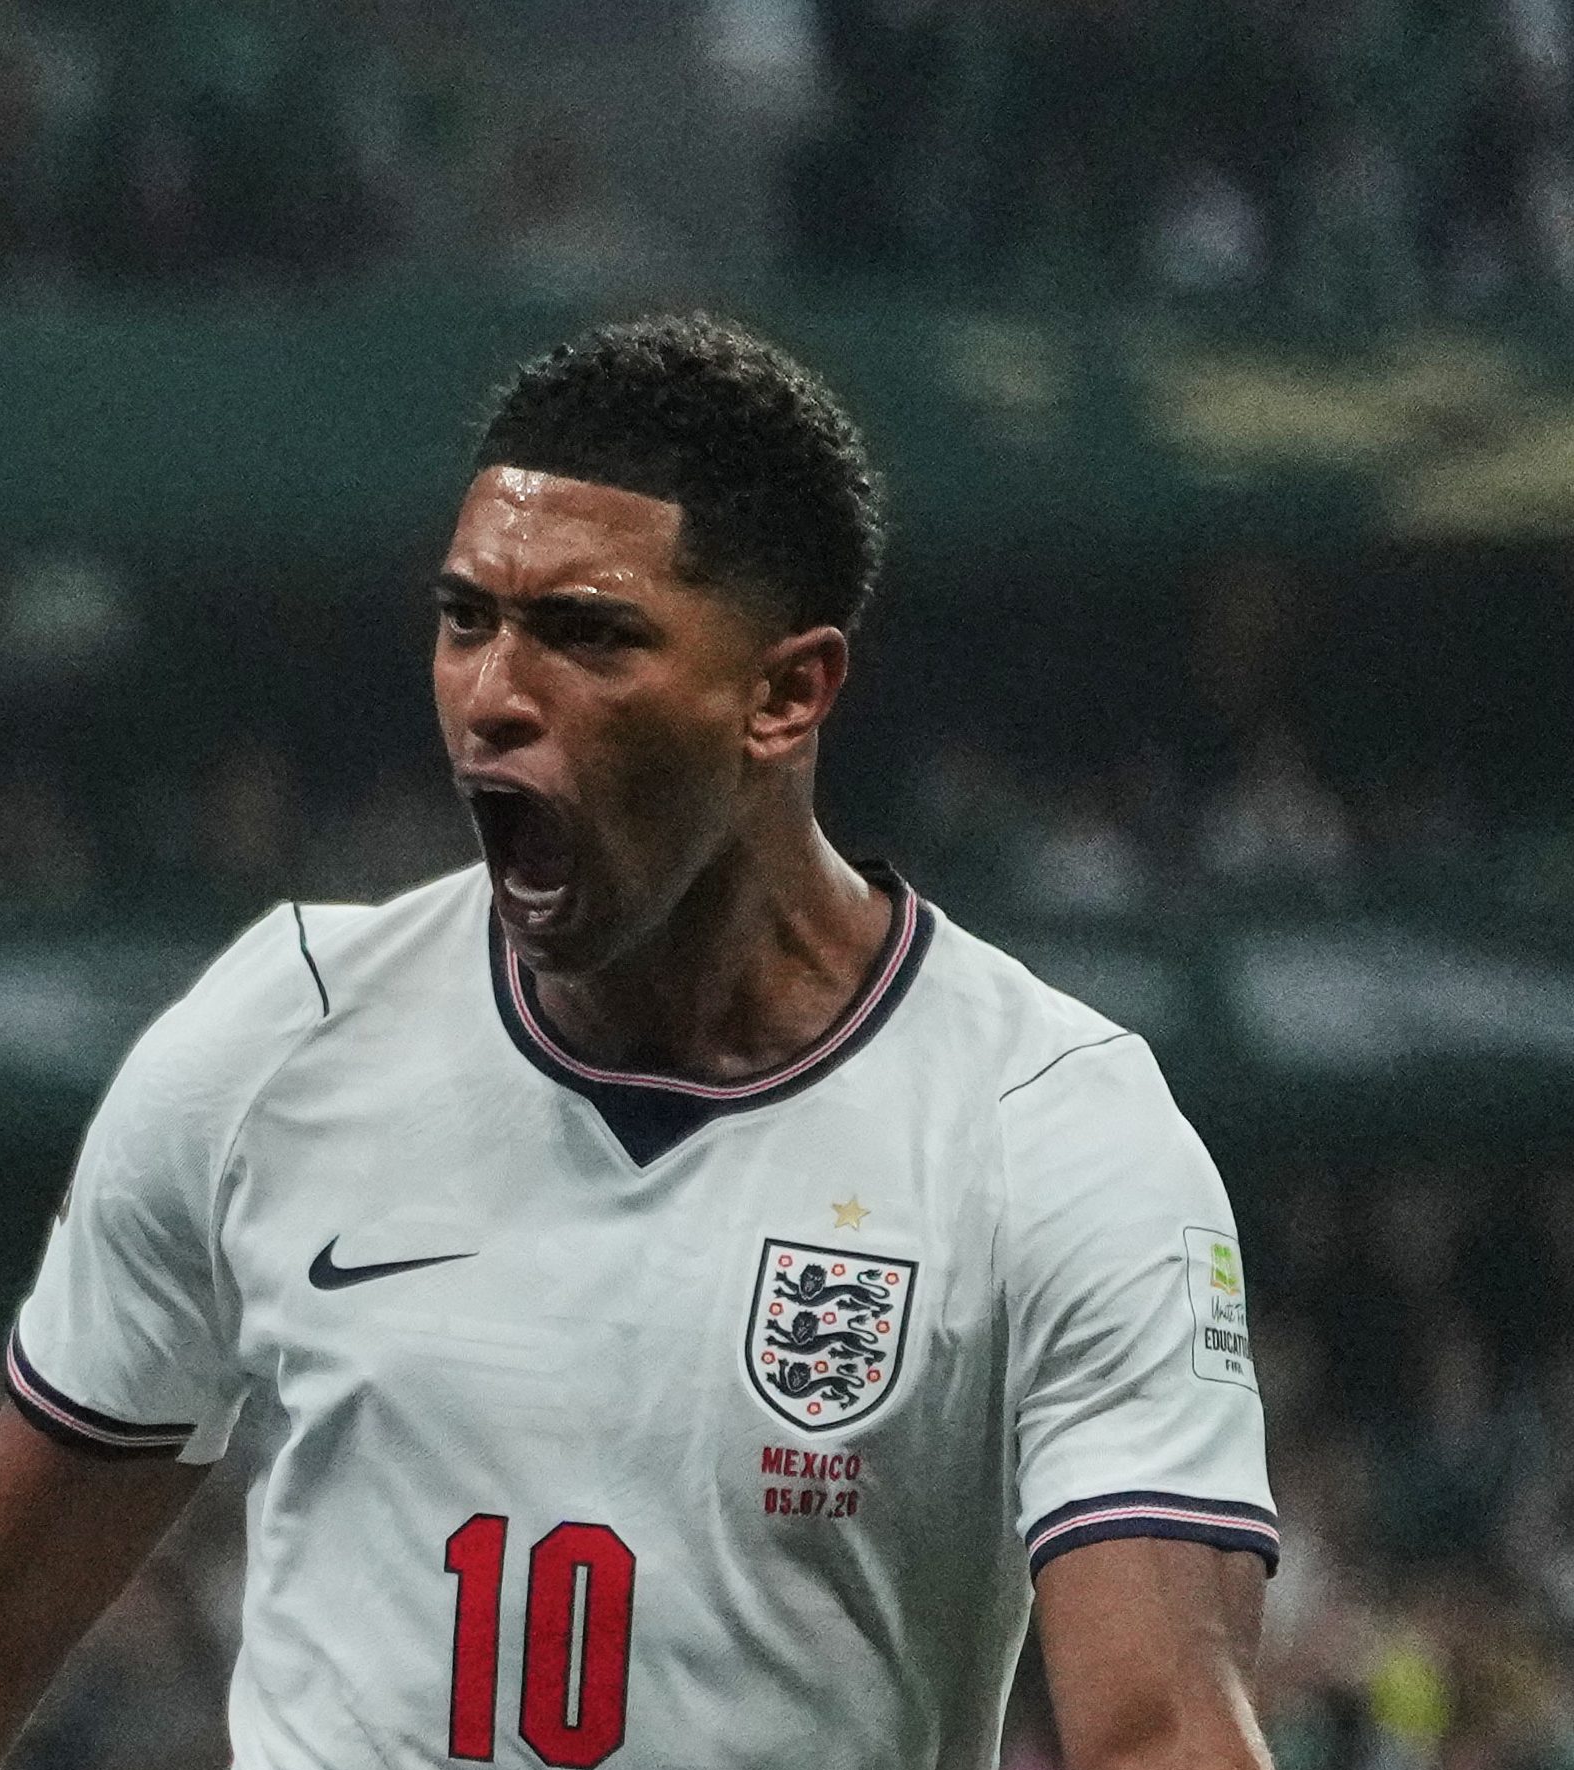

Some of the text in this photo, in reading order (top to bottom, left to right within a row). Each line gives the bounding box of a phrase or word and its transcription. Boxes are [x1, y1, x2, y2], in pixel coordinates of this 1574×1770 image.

[1204, 1327, 1253, 1361] EDUCATI
[761, 1446, 862, 1481] MEXICO
[444, 1513, 637, 1770] 10
